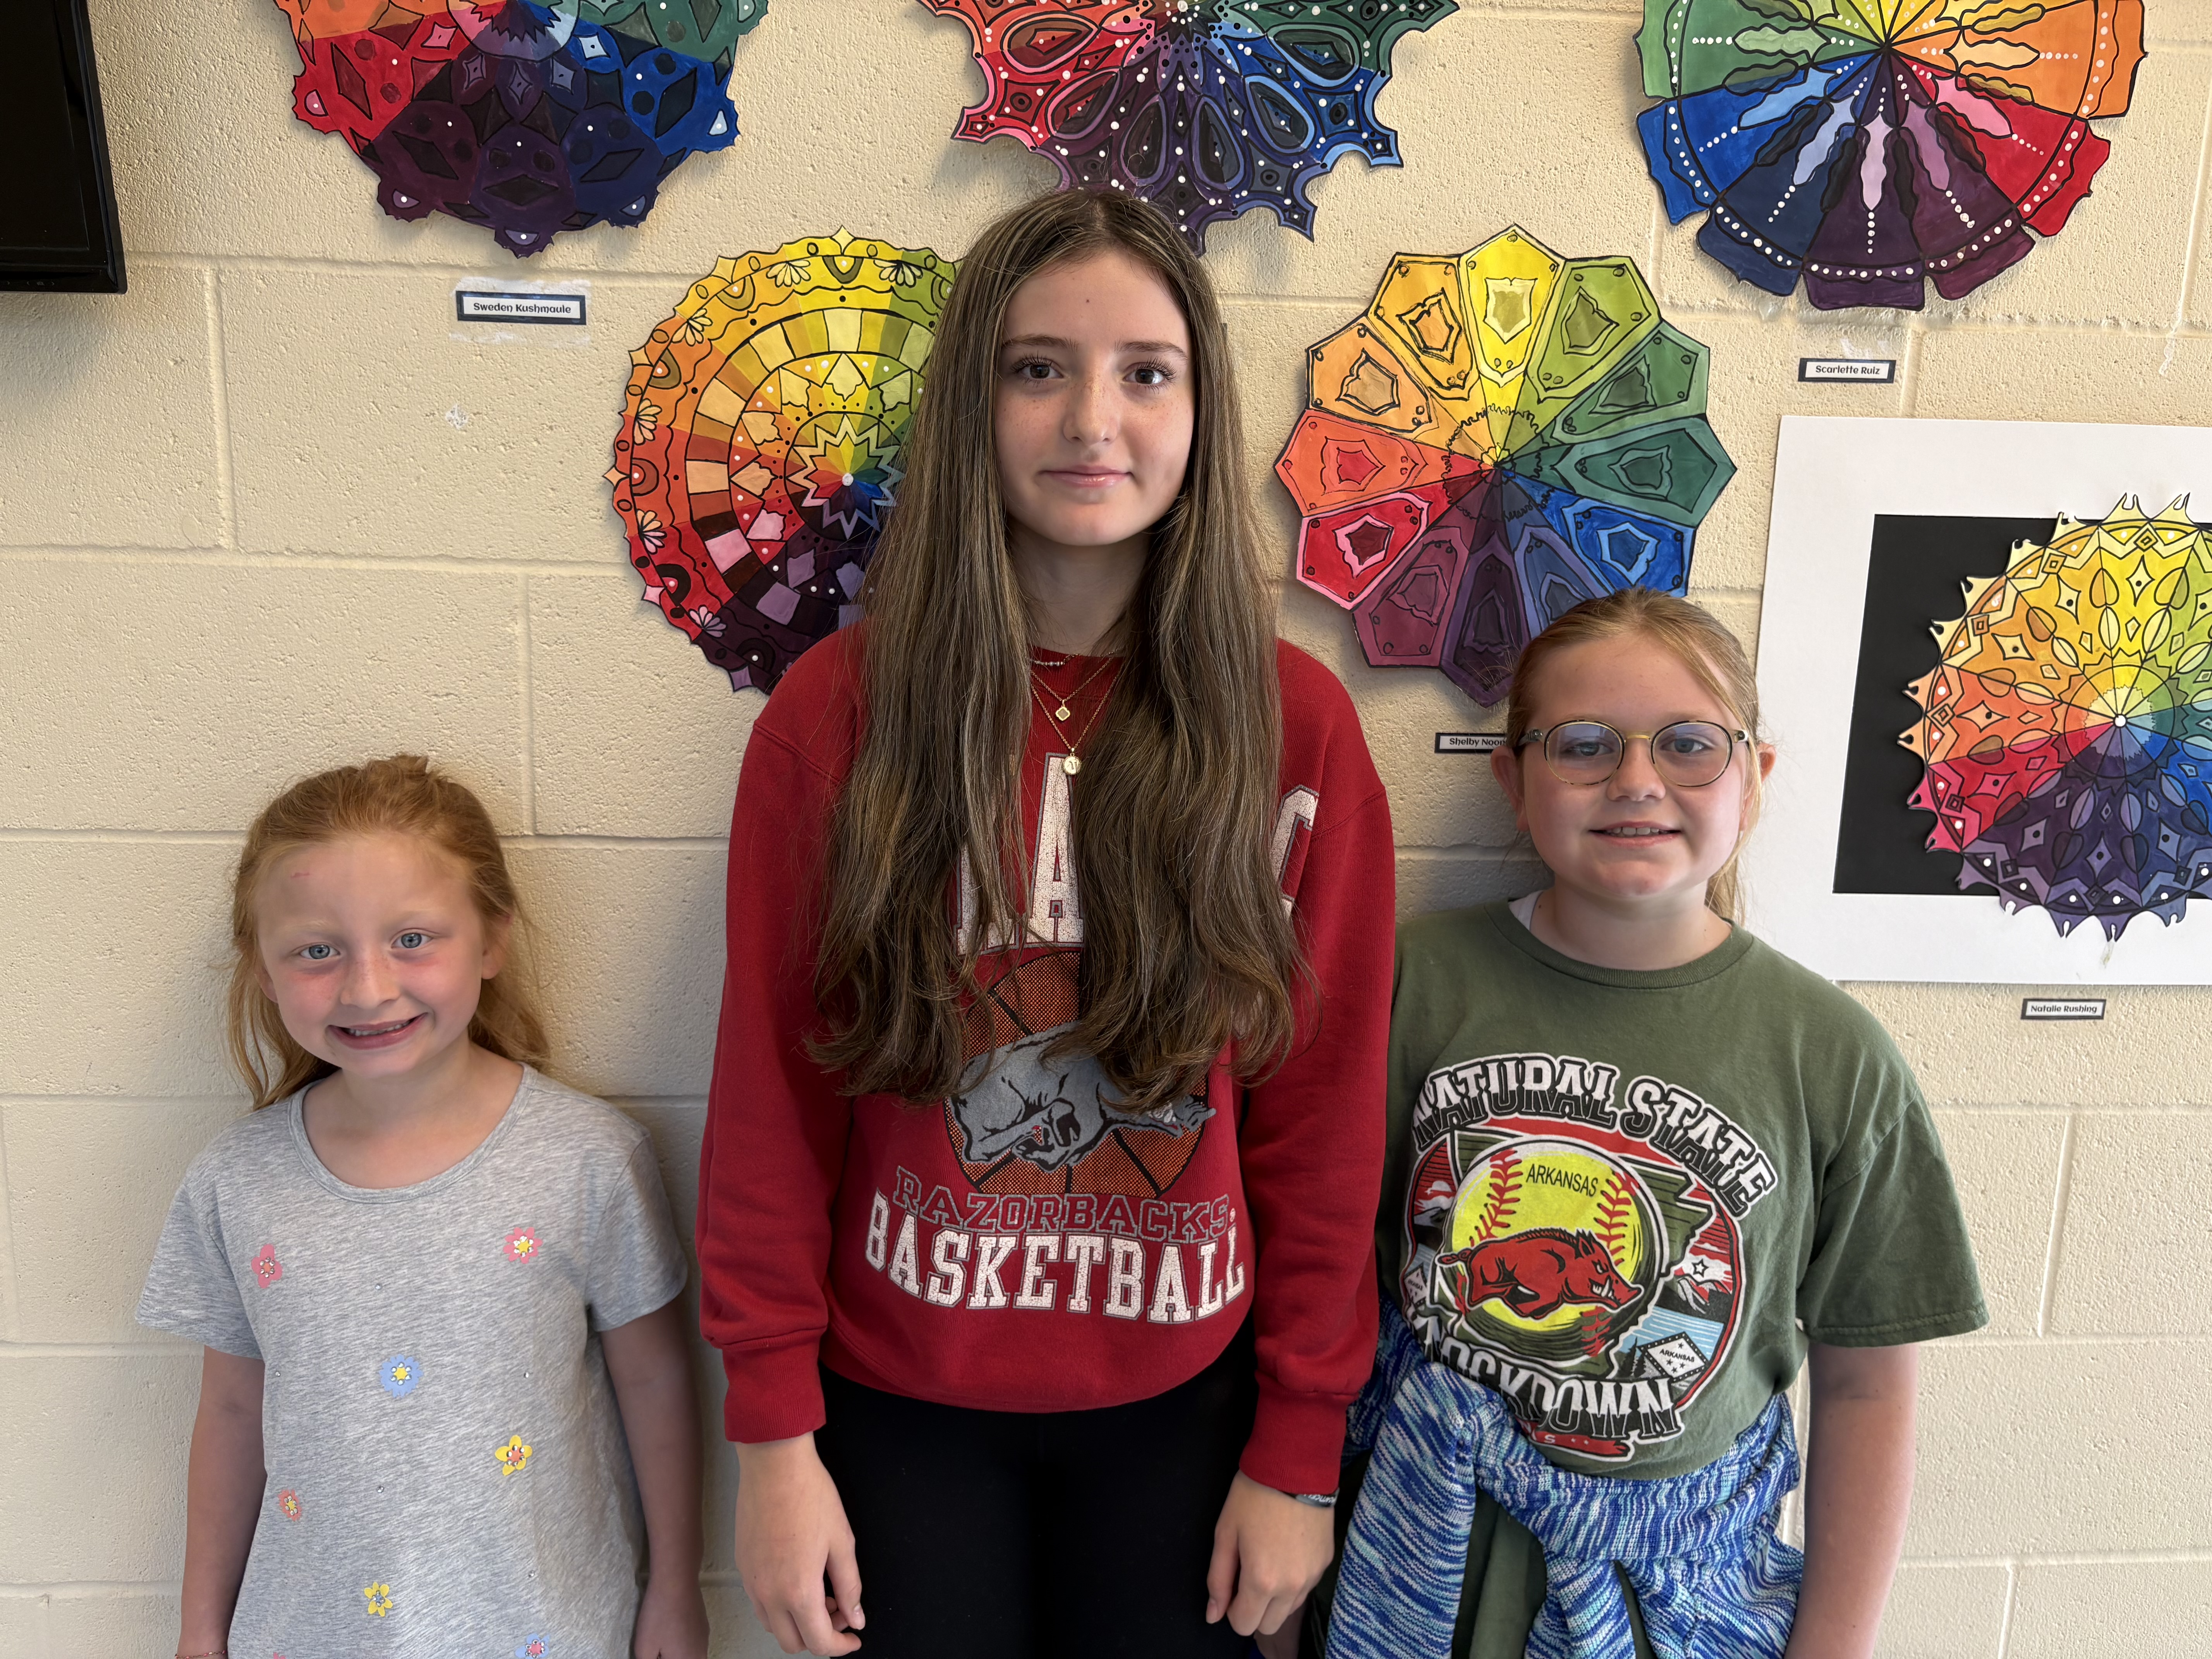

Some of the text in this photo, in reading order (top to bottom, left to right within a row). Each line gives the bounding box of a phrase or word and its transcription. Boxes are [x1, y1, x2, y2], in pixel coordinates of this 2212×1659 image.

[473, 302, 571, 313] Sweden Kushmaule
[1815, 365, 1880, 375] Scarlette Ruiz
[1449, 738, 1479, 747] Shelby
[2064, 1005, 2097, 1013] Rushing
[1414, 1056, 1776, 1216] NATURAL STATE
[1526, 1163, 1598, 1197] ARKANSAS
[892, 1166, 1230, 1243] RAZORBACKS
[865, 1187, 1245, 1324] BASKETBALL
[1659, 1348, 1695, 1363] ARKANSAS
